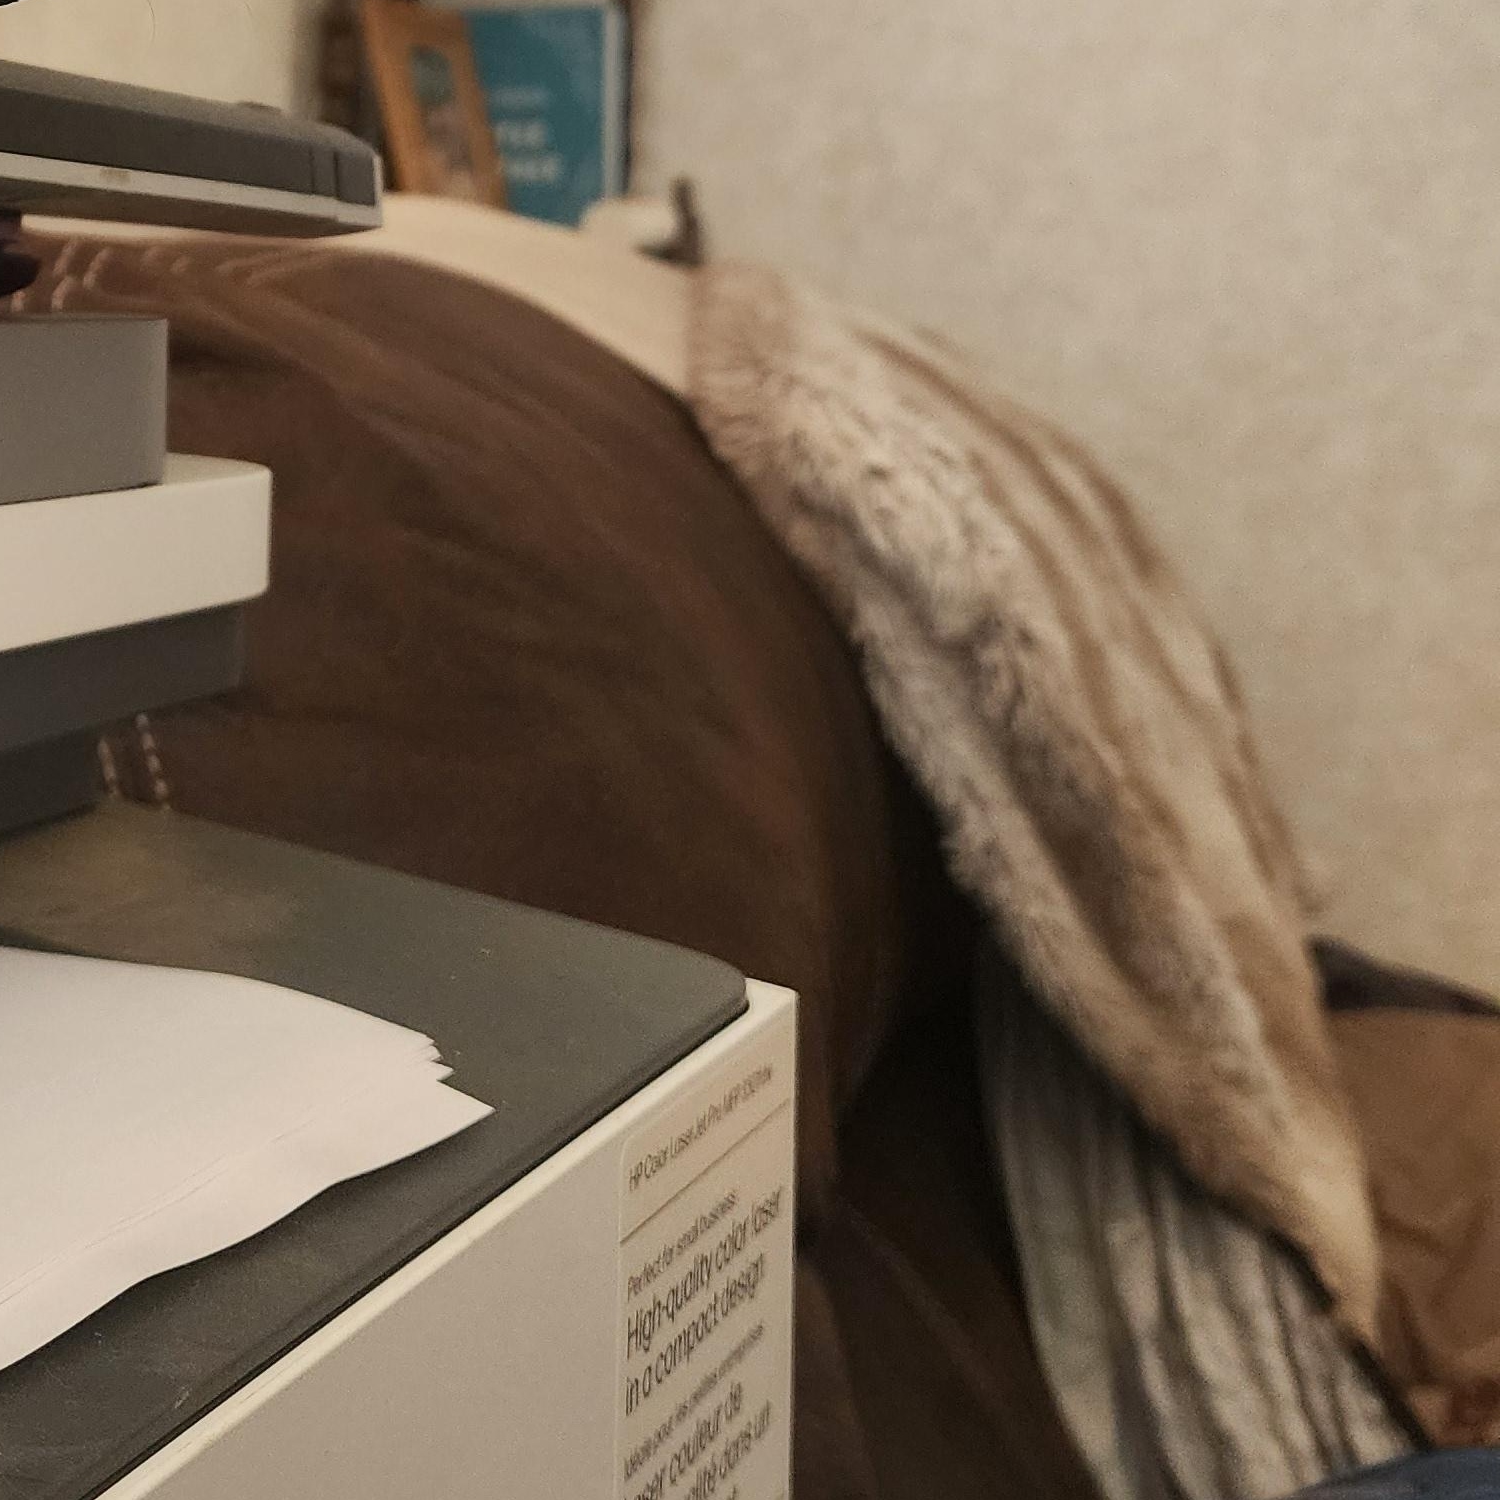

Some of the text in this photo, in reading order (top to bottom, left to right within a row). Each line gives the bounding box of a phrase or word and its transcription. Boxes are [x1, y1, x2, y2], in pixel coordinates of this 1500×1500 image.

[629, 1161, 643, 1192] HP
[644, 1145, 669, 1180] Color
[626, 1251, 713, 1361] High-quality
[714, 1214, 750, 1272] color
[751, 1185, 782, 1239] laser
[627, 1253, 661, 1304] Perfect
[676, 1217, 699, 1256] small
[625, 1376, 639, 1417] in
[642, 1365, 651, 1398] a
[655, 1291, 719, 1385] compact
[719, 1251, 764, 1319] design
[668, 1402, 722, 1486] couleur
[724, 1380, 742, 1423] de
[718, 1420, 752, 1481] dans
